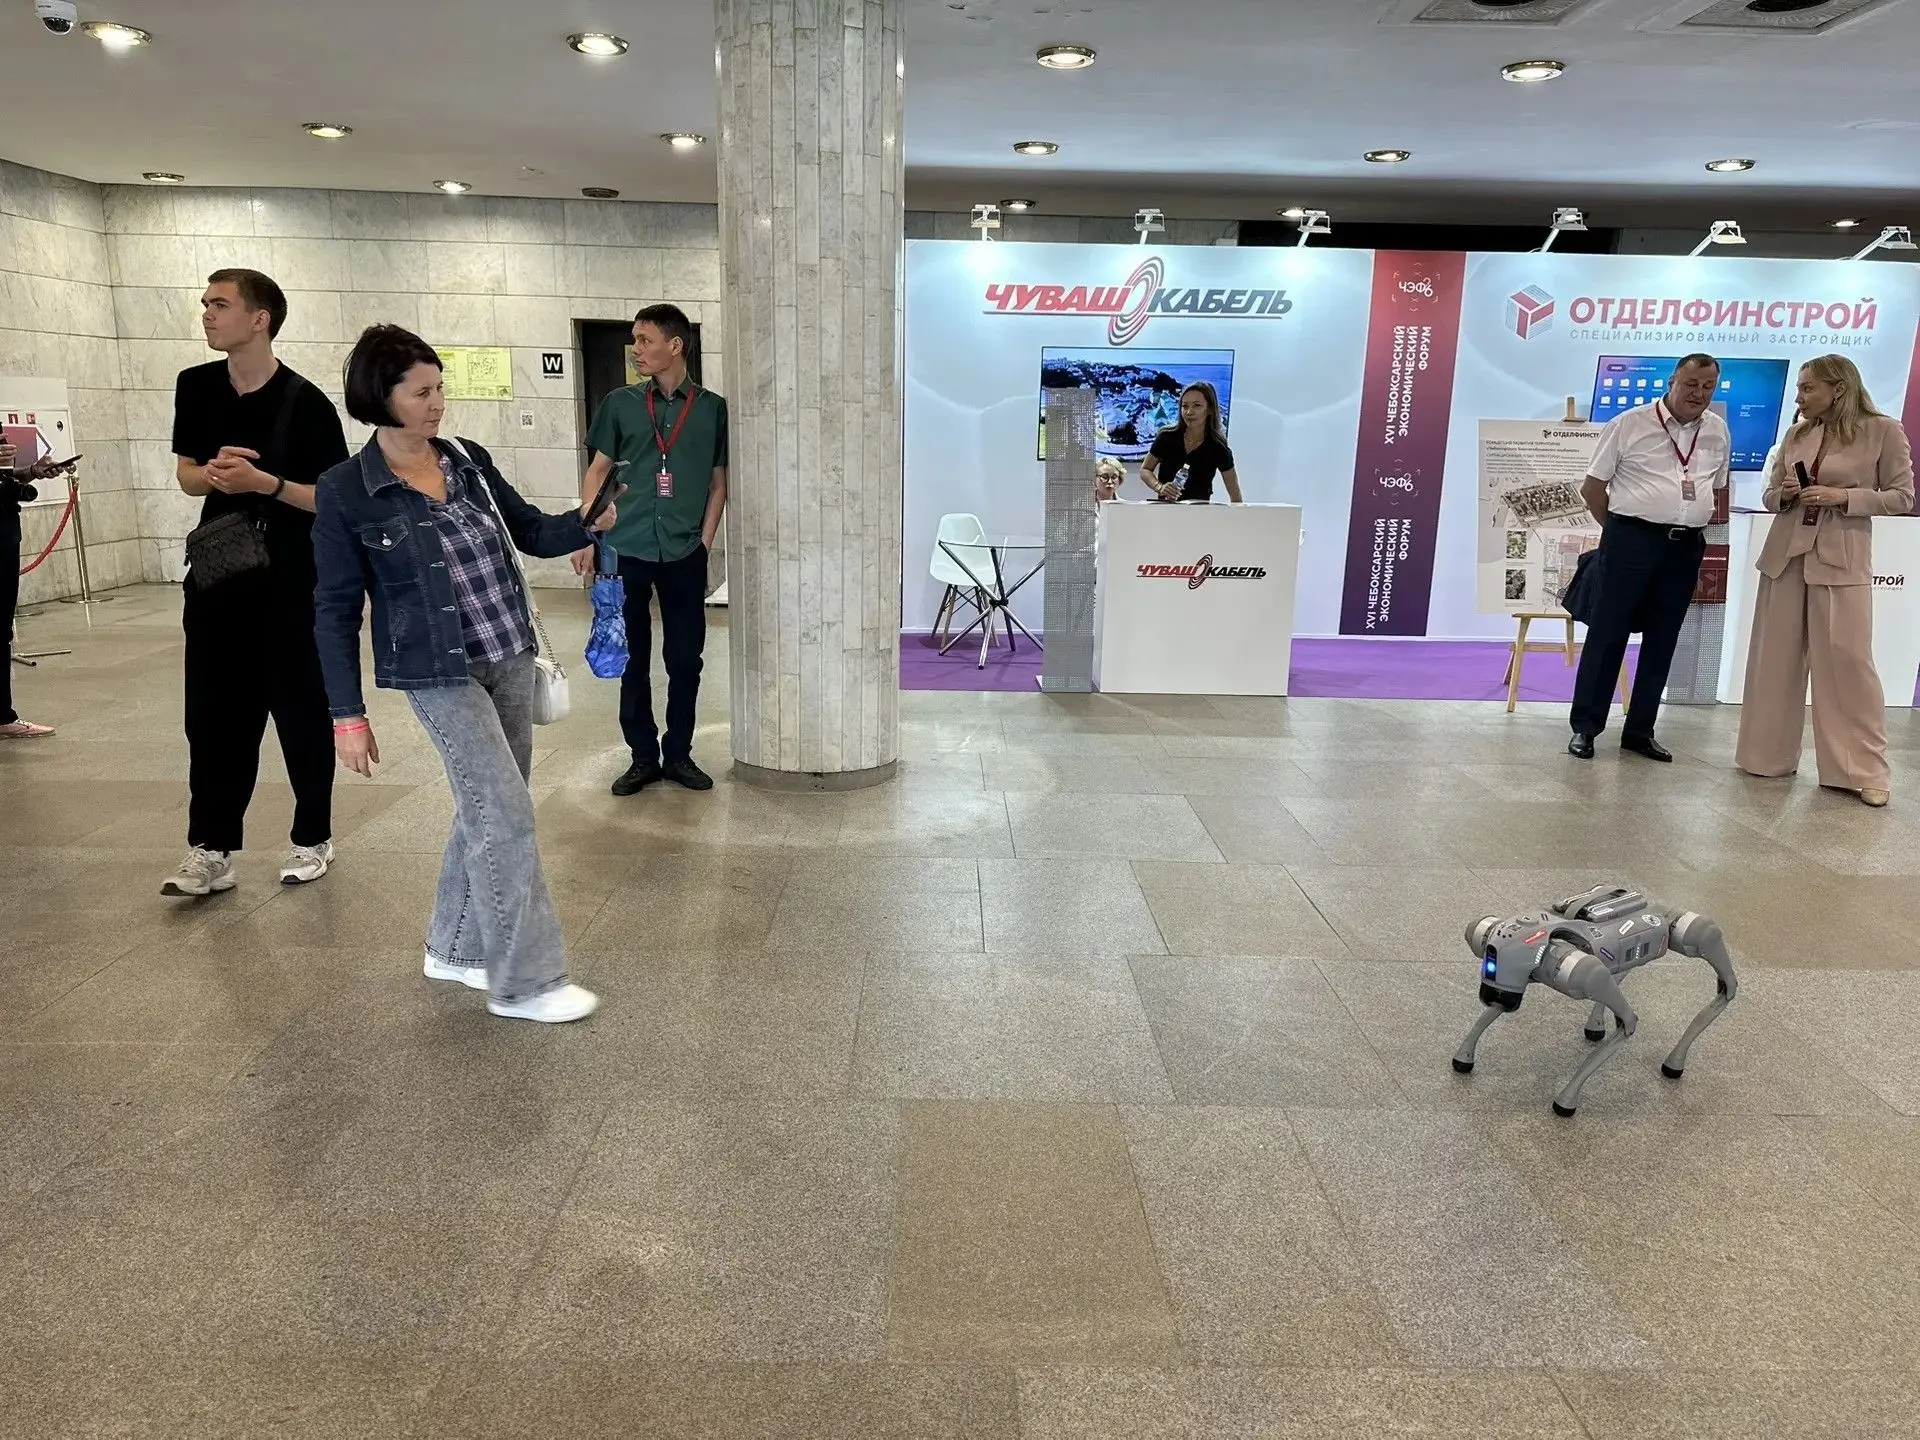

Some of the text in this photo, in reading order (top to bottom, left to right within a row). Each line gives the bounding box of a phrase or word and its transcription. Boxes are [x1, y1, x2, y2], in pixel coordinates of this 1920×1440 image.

[1569, 297, 1877, 330] ОТДЕЛФИНСТРОЙ
[1418, 326, 1431, 370] ФОРУМ
[1570, 329, 1873, 346] СПЕЦИАЛИЗИРОВАННЫЙ ЗАСТРОЙЩИК
[544, 356, 561, 371] W
[1384, 325, 1405, 444] XVI ЧЕБОКСАРСКИЙ
[1398, 326, 1418, 437] ЭКОНОМИЧЕСКИЙ
[1399, 519, 1411, 560] ФОРУМ
[1366, 518, 1386, 629] XVI ЧЕБОКСАРСКИЙ
[1379, 519, 1398, 622] ЭКОНОМИЧЕСКИЙ
[1872, 574, 1904, 586] ТРОЙ
